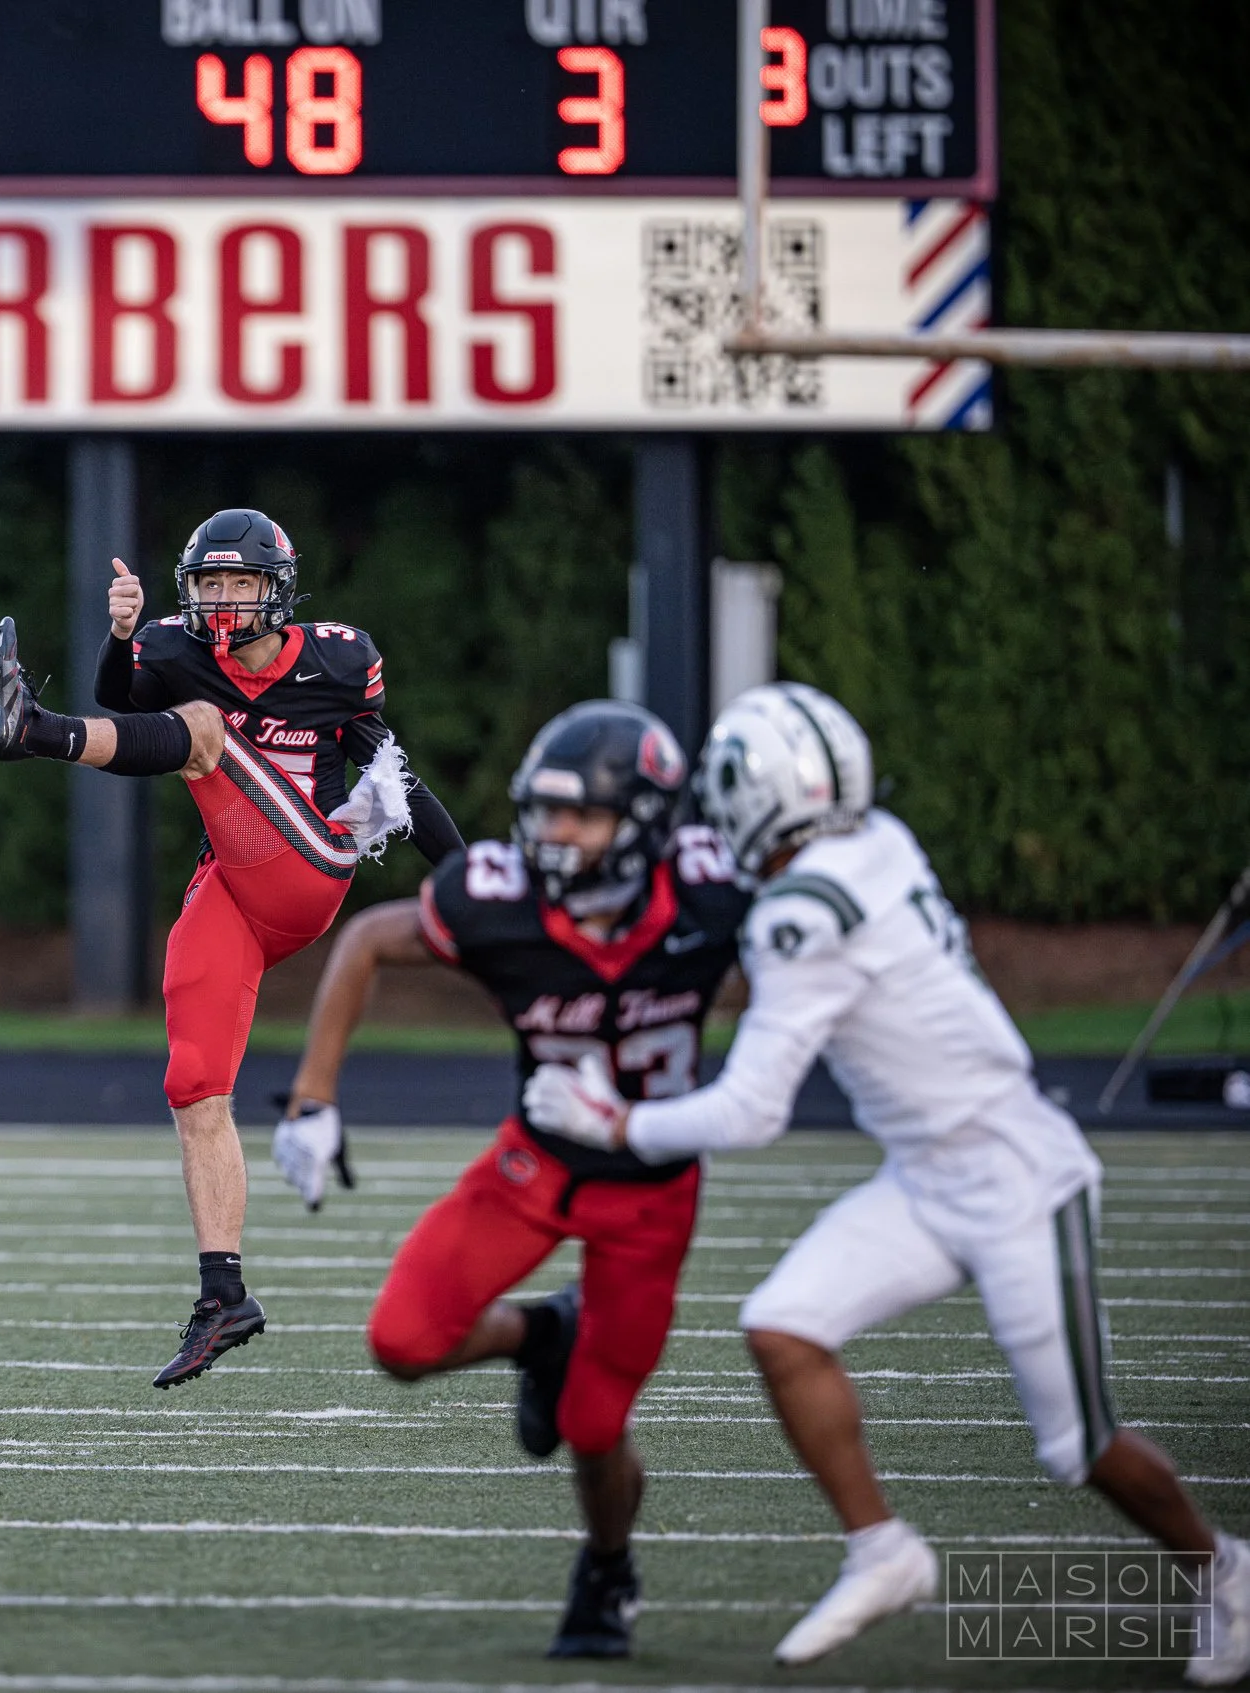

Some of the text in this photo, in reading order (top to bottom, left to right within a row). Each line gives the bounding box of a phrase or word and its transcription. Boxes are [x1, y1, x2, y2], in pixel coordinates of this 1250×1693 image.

[759, 27, 807, 126] 3
[808, 44, 954, 108] OUTS
[196, 47, 362, 175] 48
[557, 46, 625, 175] 3
[820, 112, 954, 177] LEFT
[207, 553, 238, 561] Riddell
[255, 716, 319, 747] Town
